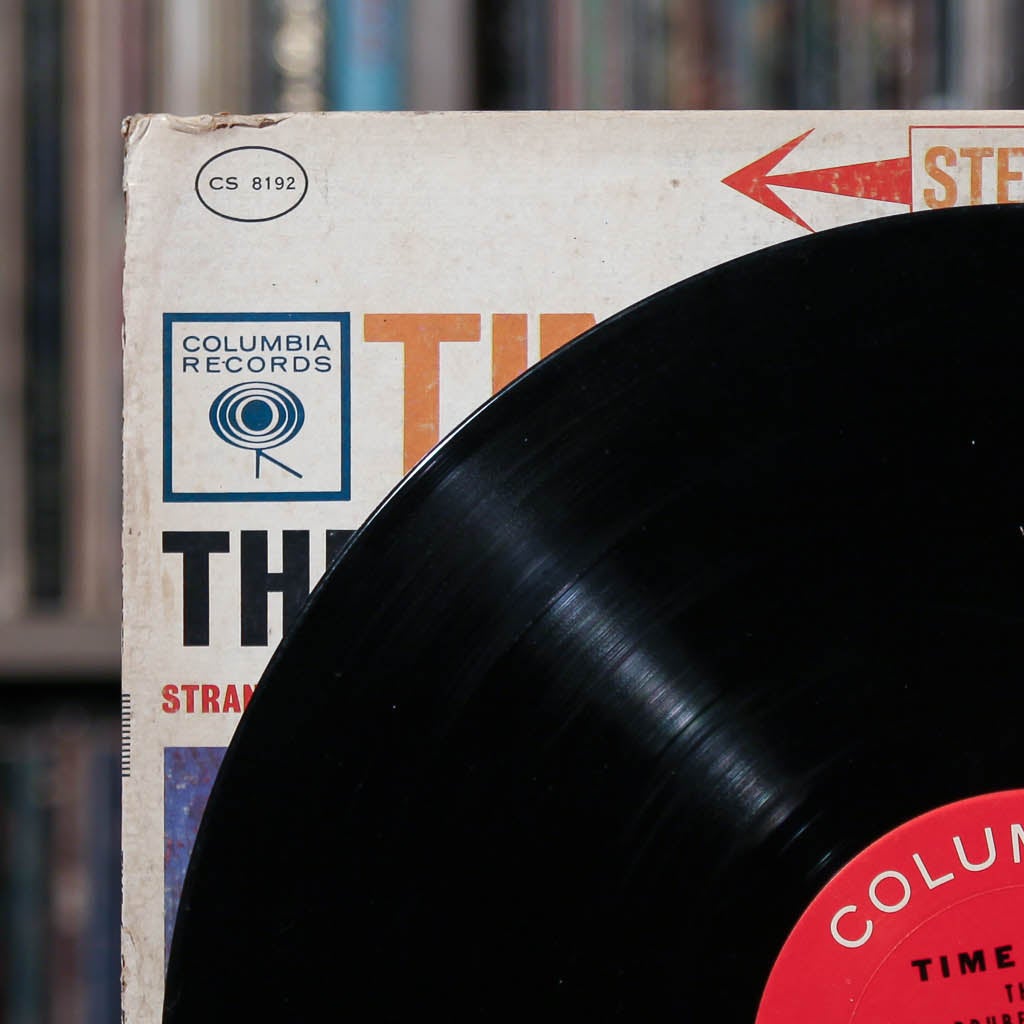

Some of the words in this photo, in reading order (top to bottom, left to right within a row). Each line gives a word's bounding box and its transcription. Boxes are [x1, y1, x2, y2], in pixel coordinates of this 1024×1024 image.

[209, 176, 239, 191] CS
[252, 176, 296, 191] 8192
[182, 334, 331, 353] COLUMBIA
[182, 355, 332, 374] RECORDS
[162, 530, 356, 647] TH
[911, 944, 1016, 982] TIME
